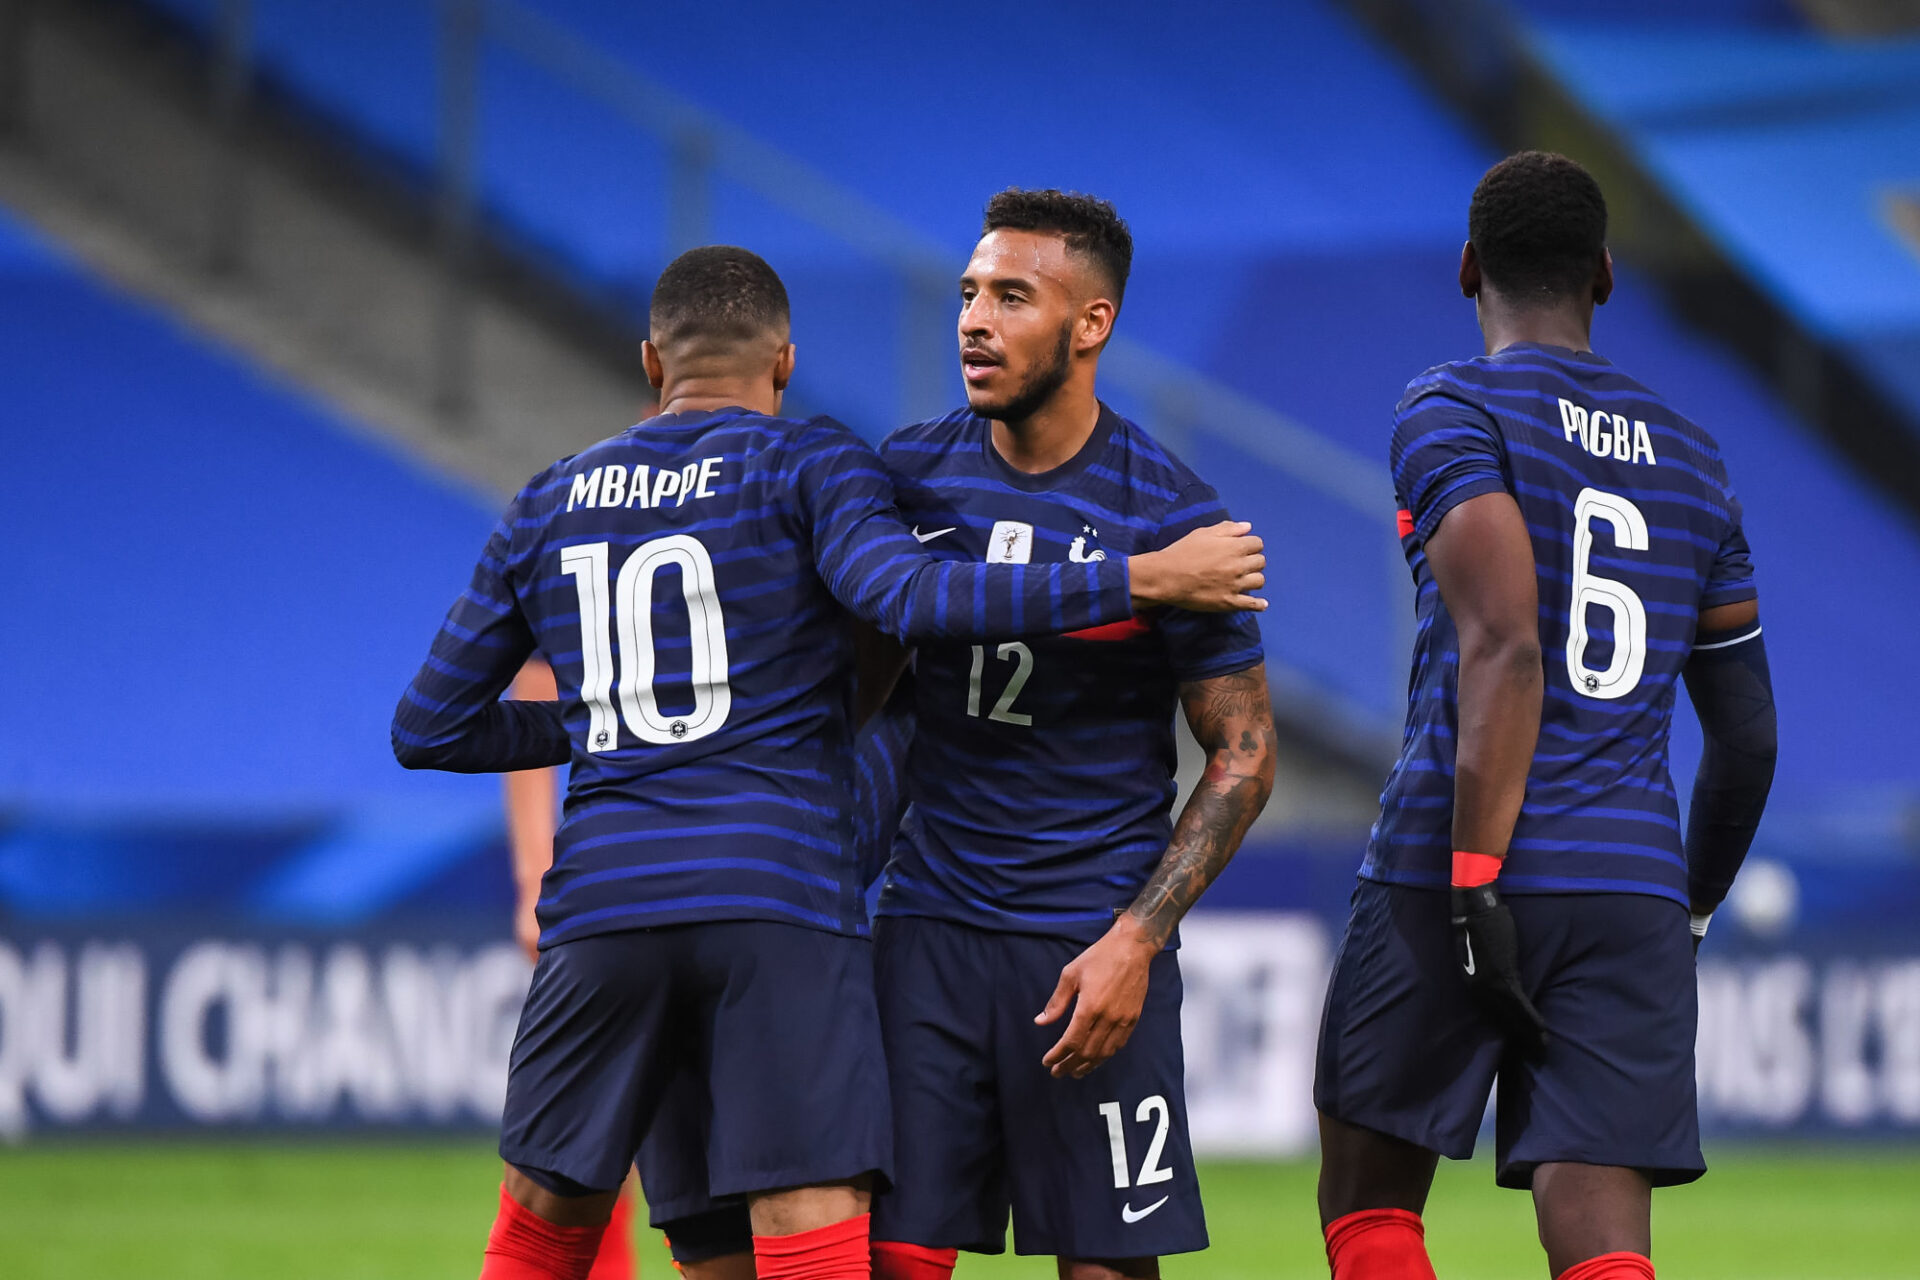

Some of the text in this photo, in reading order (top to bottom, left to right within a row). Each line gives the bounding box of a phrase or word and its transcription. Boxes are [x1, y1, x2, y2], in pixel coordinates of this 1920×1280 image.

[1557, 397, 1657, 465] POGBA
[566, 456, 724, 513] MBAPPE
[1566, 486, 1649, 700] 6
[560, 533, 732, 754] 10
[966, 640, 1034, 727] 12
[1098, 1094, 1174, 1189] 12
